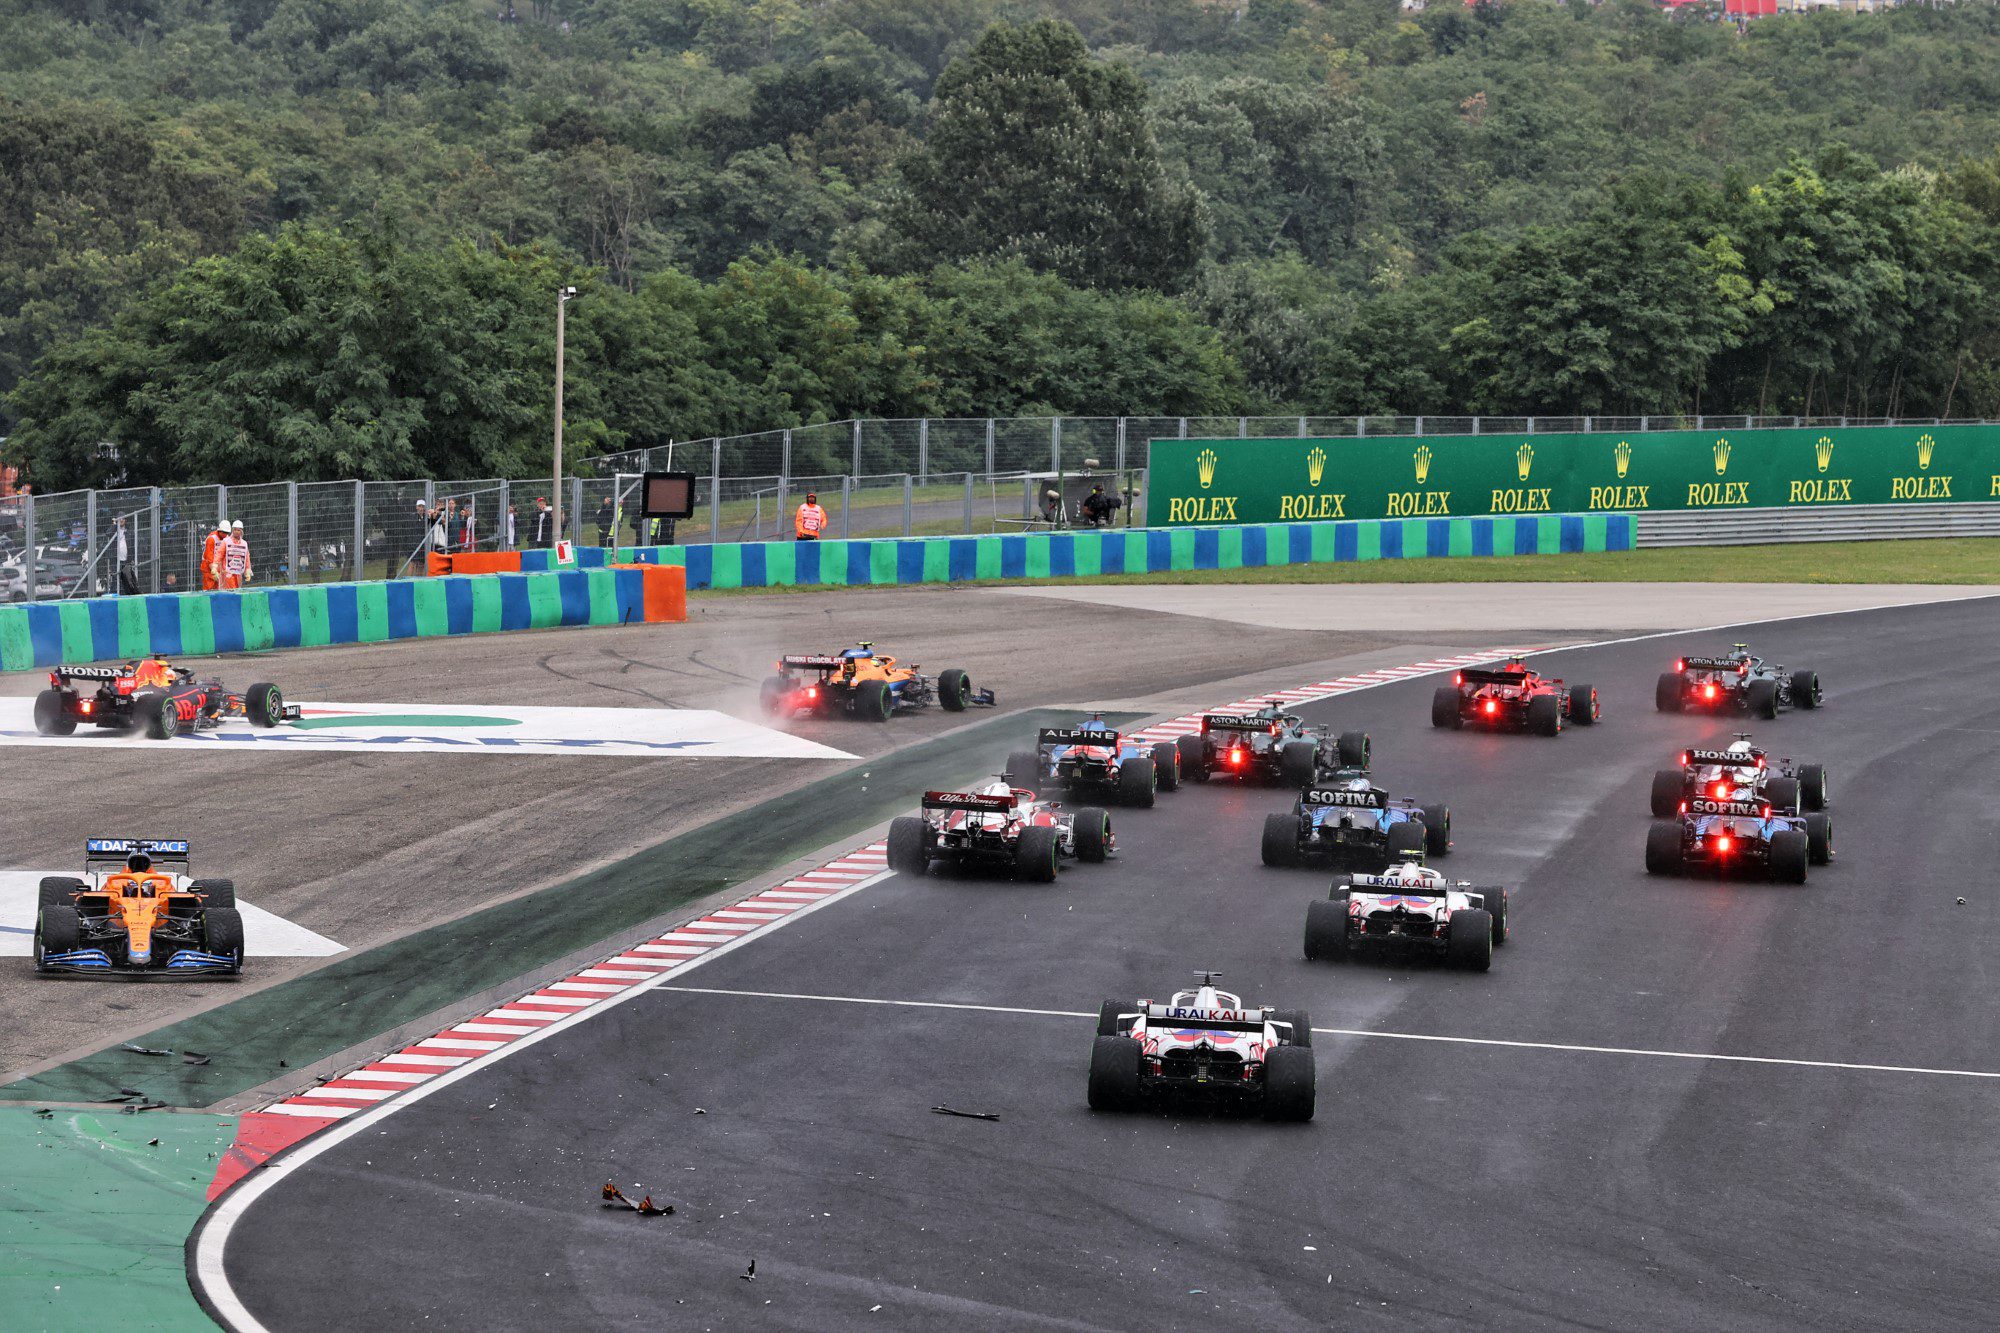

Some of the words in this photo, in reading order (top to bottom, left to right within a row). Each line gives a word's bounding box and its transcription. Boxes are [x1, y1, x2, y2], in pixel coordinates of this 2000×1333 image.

[1687, 482, 1750, 505] ROLEX
[1789, 479, 1852, 502] ROLEX
[1892, 476, 1952, 499] ROLEX
[1387, 492, 1450, 516] ROLEX
[1490, 489, 1551, 512] ROLEX
[1590, 486, 1650, 509] ROLEX
[1168, 497, 1238, 522] ROLEX
[1280, 495, 1346, 519] ROLEX
[807, 656, 847, 664] CHOCOLATE
[60, 666, 123, 677] HONDA
[1210, 717, 1239, 725] ASTON
[1241, 718, 1273, 726] MARTIN
[1045, 729, 1115, 740] ALPINE
[1693, 749, 1755, 761] HONDA
[939, 793, 963, 803] Alfa
[963, 795, 1000, 805] Romeo
[1309, 790, 1378, 807] SOFINA
[1692, 800, 1761, 816] SOFINA
[1366, 876, 1433, 889] URALKALI
[1165, 1007, 1246, 1022] URALKALI
